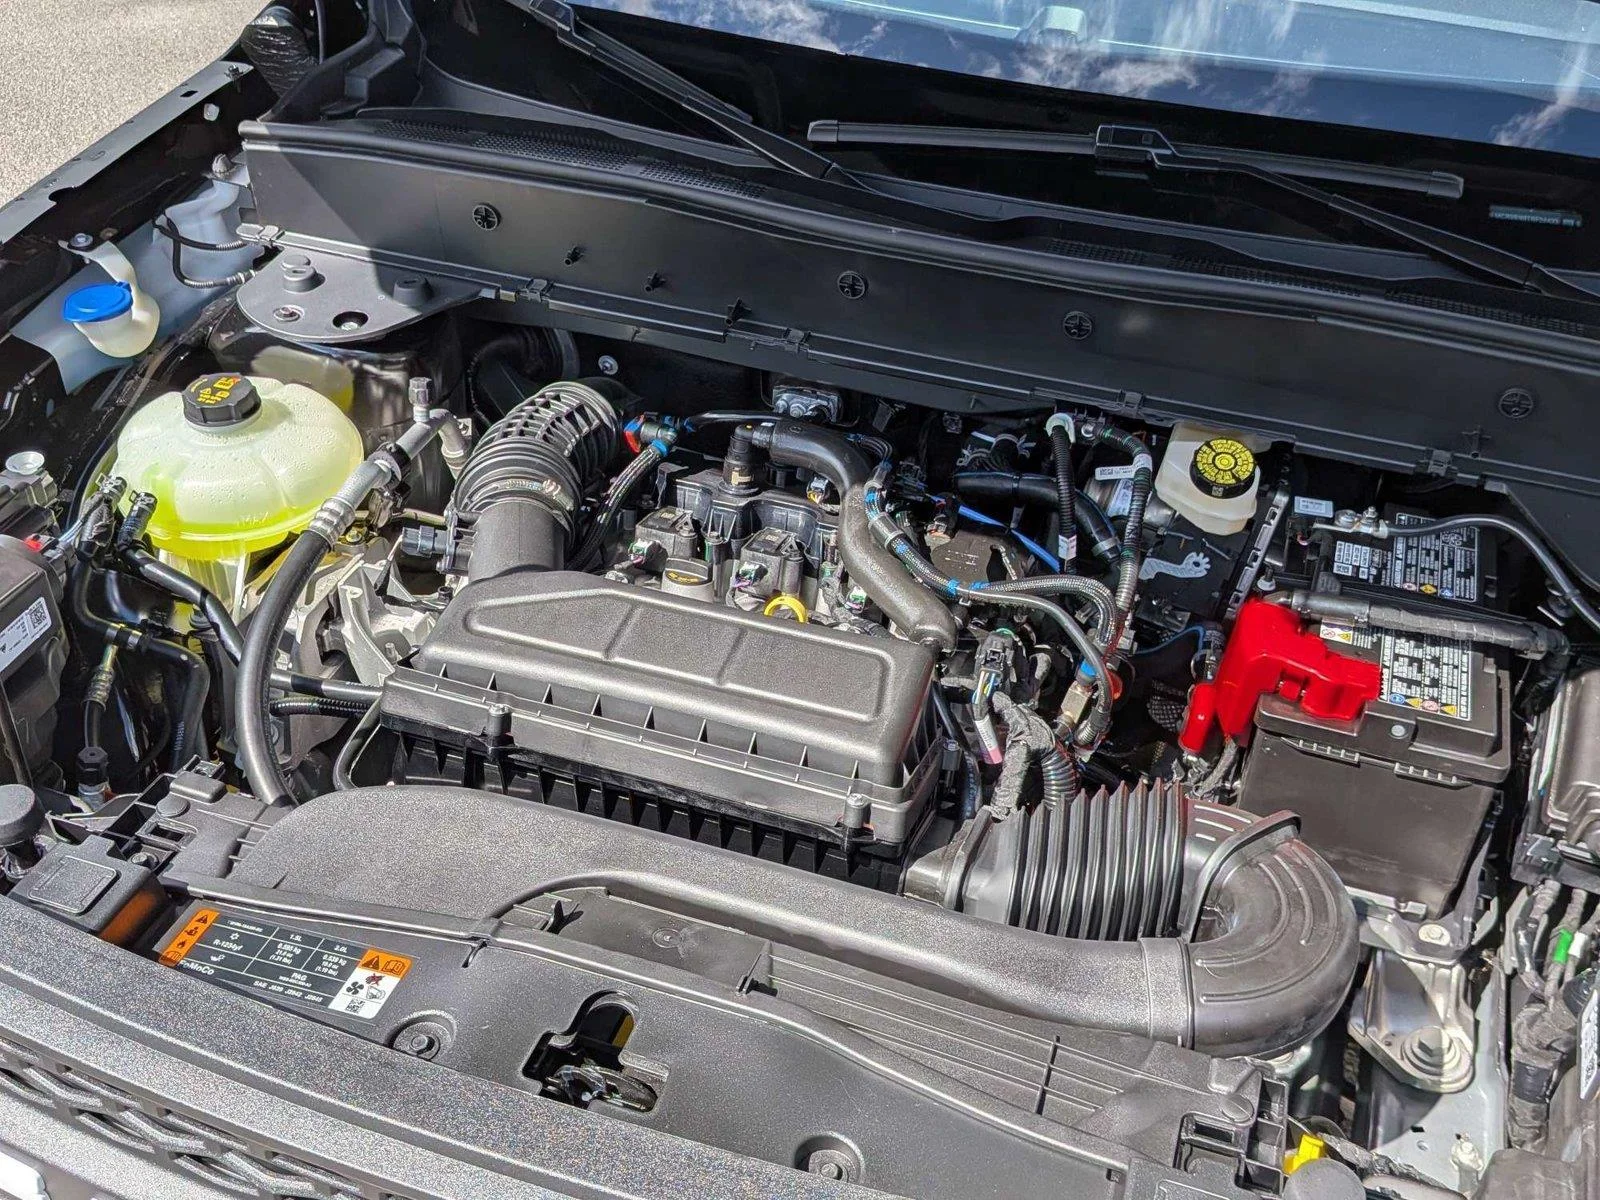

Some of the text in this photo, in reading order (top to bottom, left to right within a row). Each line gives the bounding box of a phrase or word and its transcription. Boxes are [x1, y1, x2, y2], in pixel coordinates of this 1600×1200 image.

[289, 934, 302, 942] 1.5L
[213, 939, 244, 951] R-1234yf
[334, 945, 348, 953] 2.0L
[338, 958, 347, 966] kg
[178, 959, 215, 976] FoMoCo
[291, 972, 308, 981] PAG
[253, 980, 268, 989] SAE
